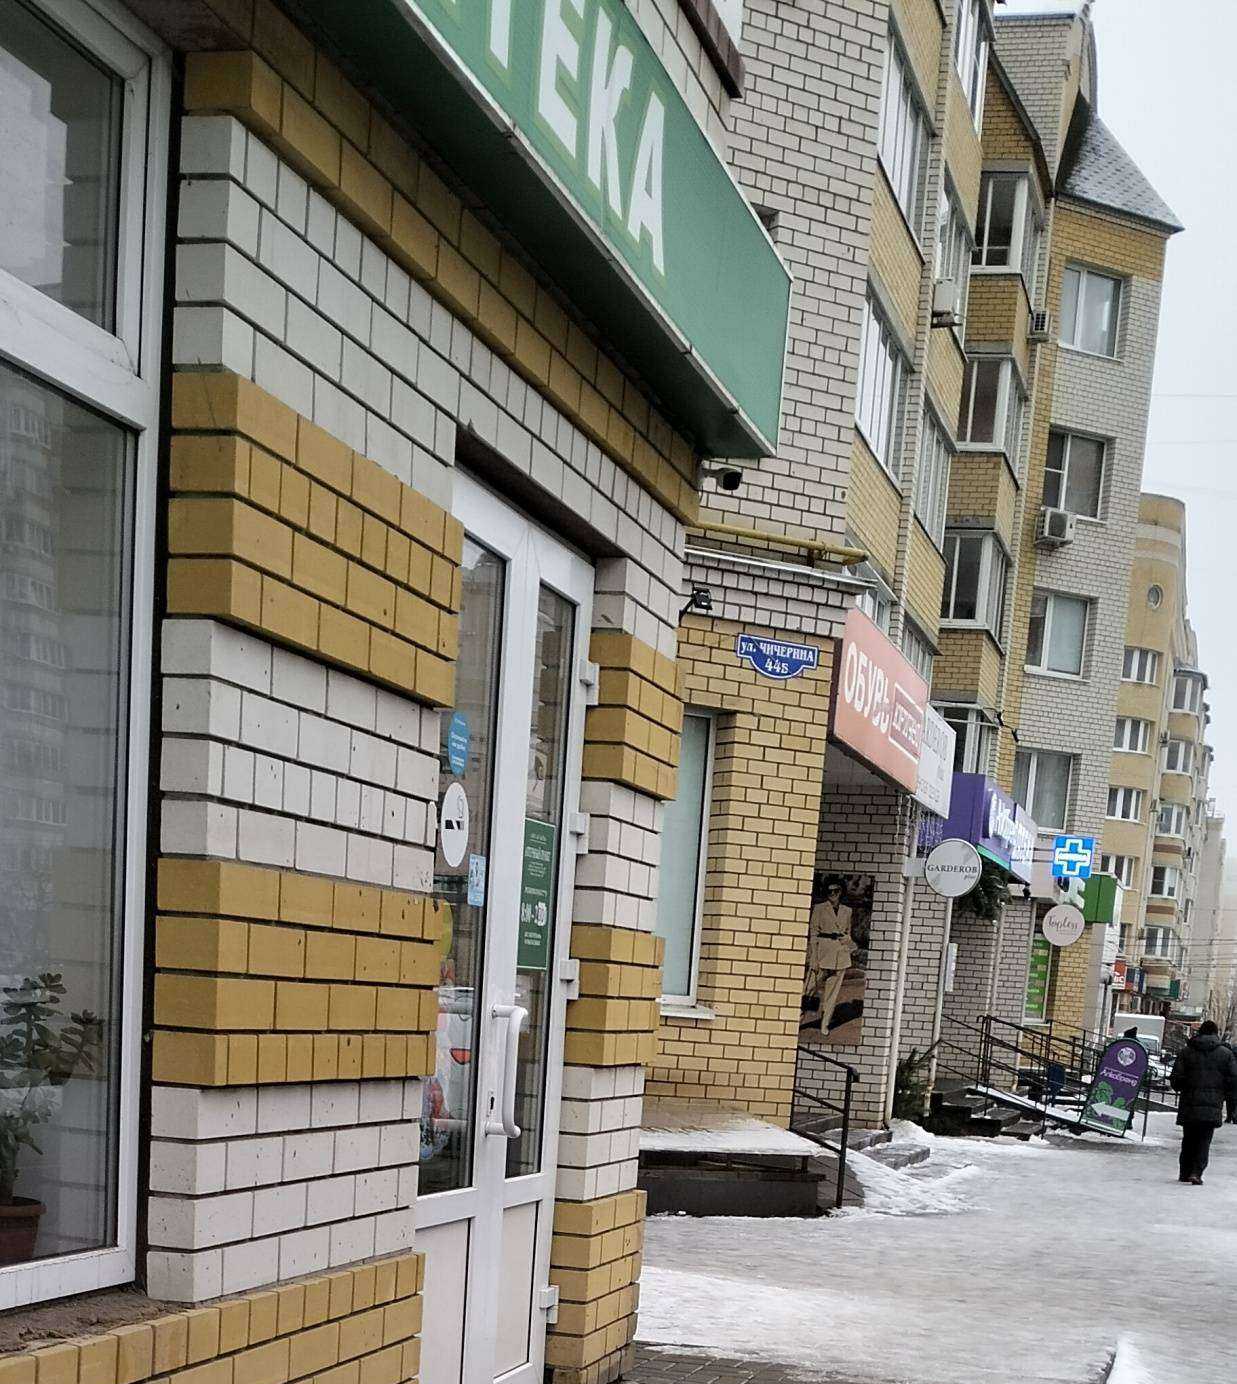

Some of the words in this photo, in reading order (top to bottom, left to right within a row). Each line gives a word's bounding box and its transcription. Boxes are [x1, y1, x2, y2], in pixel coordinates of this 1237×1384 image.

[741, 641, 757, 653] ул.
[760, 642, 814, 662] ЧИЧЕРИНА
[764, 658, 789, 674] 44Б
[844, 641, 890, 734] ОБУВЬ
[927, 864, 977, 873] GARDEROB
